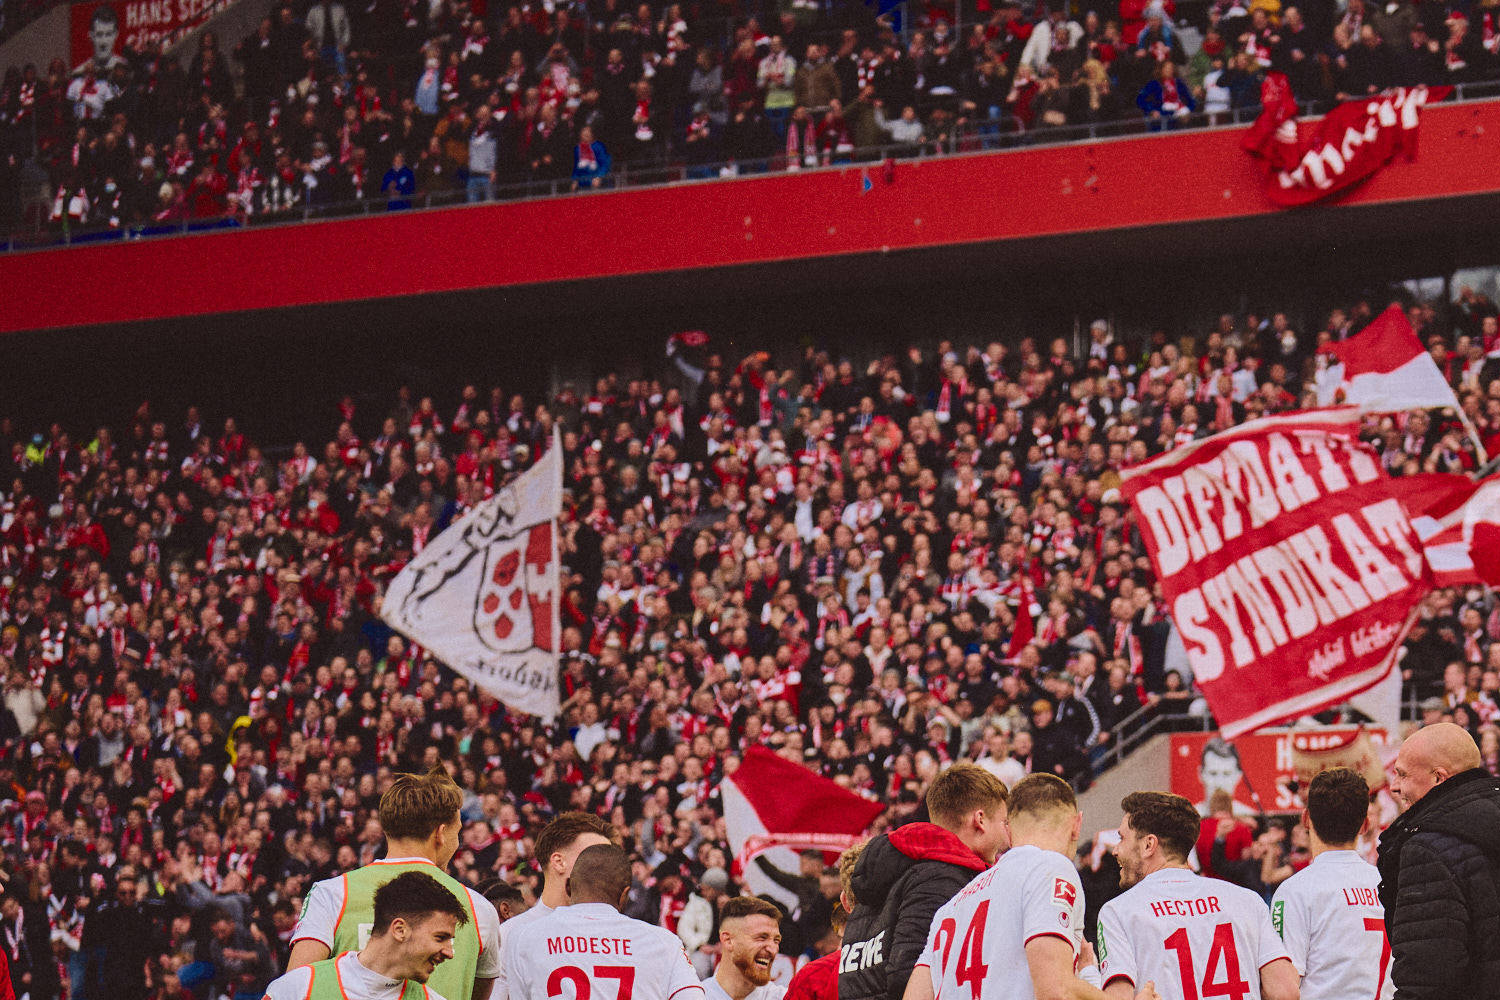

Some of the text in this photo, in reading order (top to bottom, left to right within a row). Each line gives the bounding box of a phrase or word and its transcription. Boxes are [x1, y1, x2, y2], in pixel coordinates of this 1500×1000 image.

[1174, 497, 1422, 685] SYNDIKAT
[1150, 896, 1221, 917] HECTOR
[1343, 888, 1380, 907] LJUBI
[547, 936, 633, 956] MODESTE
